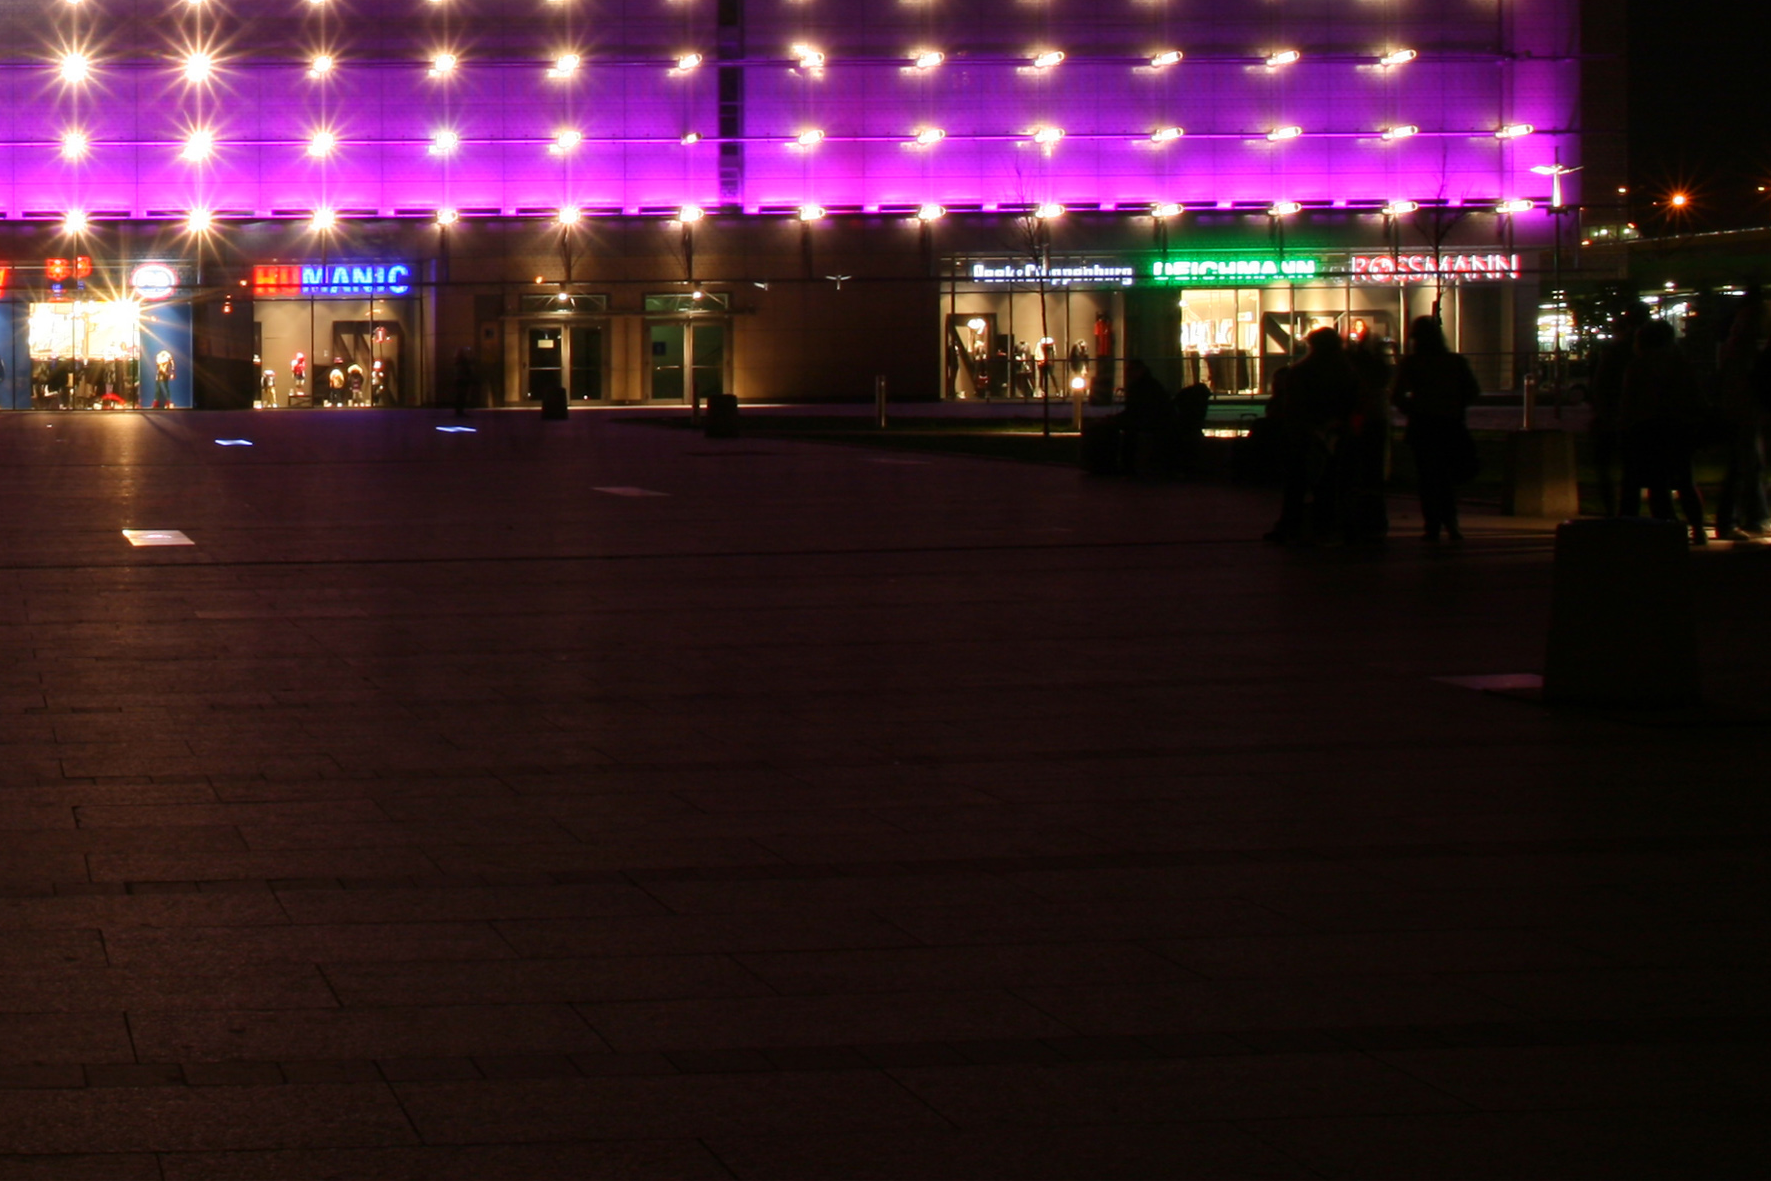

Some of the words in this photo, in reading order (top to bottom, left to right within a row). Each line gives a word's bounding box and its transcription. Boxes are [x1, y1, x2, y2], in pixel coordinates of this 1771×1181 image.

[254, 265, 410, 296] HUMANIC
[1152, 260, 1316, 281] DEICHMANN
[1350, 254, 1522, 282] ROSSMANN
